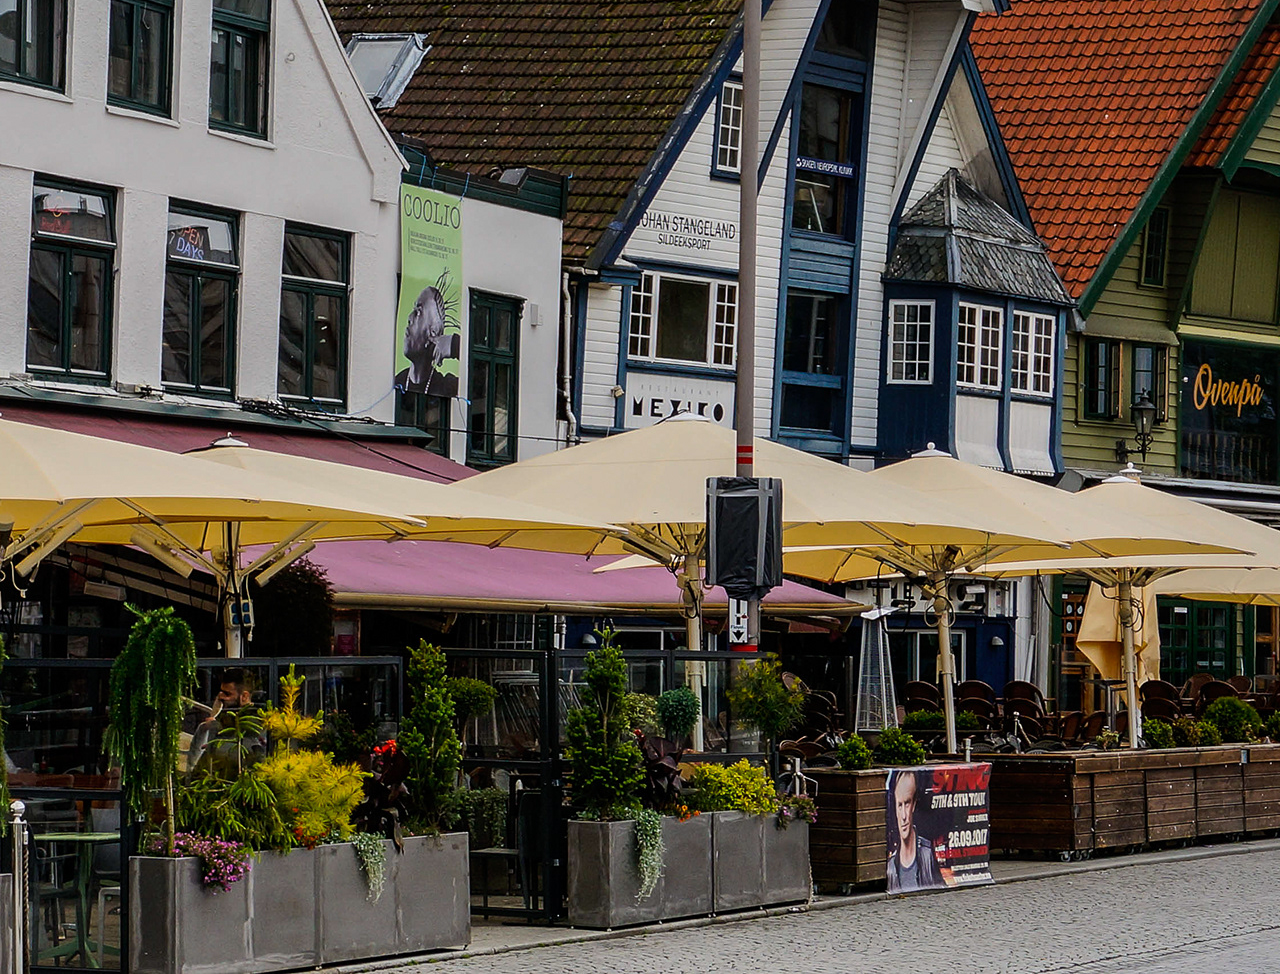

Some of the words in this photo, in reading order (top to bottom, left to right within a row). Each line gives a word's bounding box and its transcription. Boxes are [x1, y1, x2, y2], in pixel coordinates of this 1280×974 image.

[404, 193, 460, 230] COOLIO
[672, 216, 736, 239] STANGELAND
[176, 237, 204, 261] DAYS
[657, 233, 711, 251] SILDEEKSPORT
[1194, 363, 1265, 418] Ovenpå
[932, 765, 991, 793] STING
[931, 795, 947, 809] 57TH
[947, 794, 953, 807] &
[954, 793, 968, 806] 9TH
[948, 829, 988, 848] 26.09.2017
